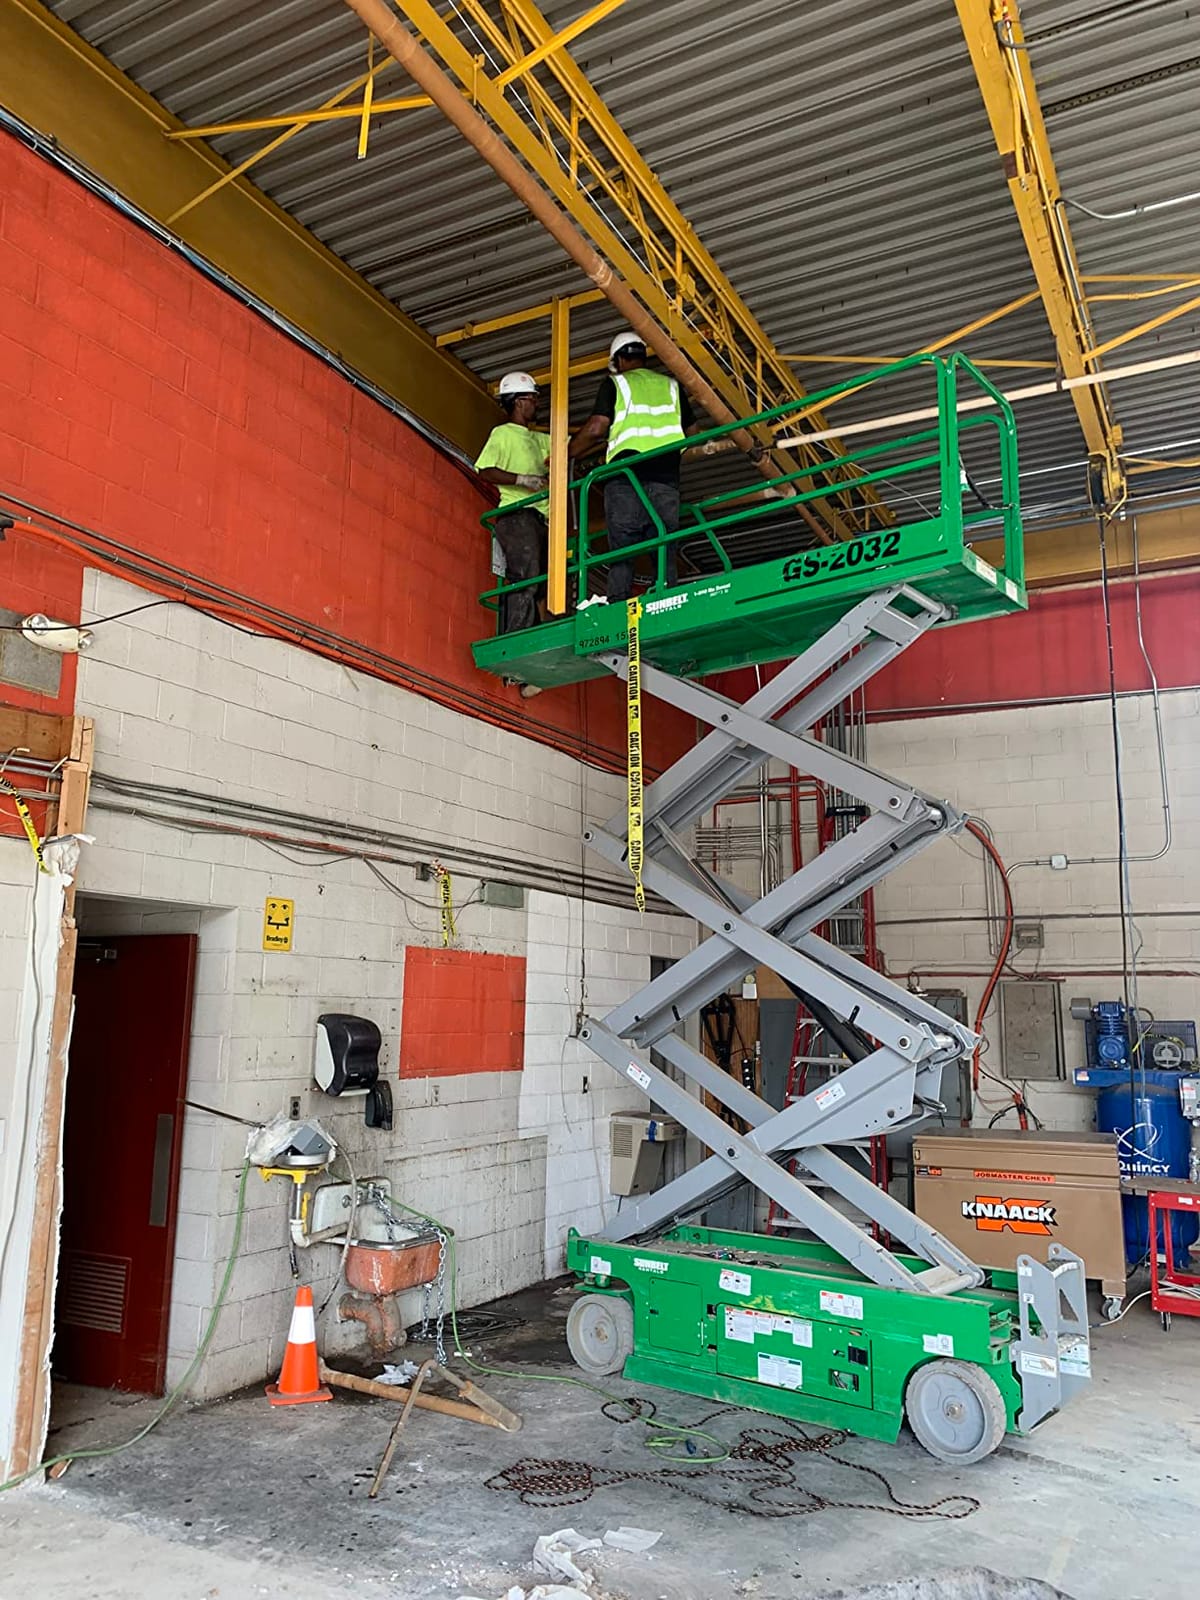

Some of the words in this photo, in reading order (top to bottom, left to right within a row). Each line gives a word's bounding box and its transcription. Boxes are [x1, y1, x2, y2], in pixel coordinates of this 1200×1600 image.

[783, 531, 901, 582] GS-2032
[645, 592, 689, 613] SUNBELT
[579, 635, 610, 648] 972894
[615, 630, 629, 641] 15
[629, 627, 638, 662] CAUTION
[629, 665, 638, 700] CAUTION
[629, 731, 640, 768] CAUTION
[630, 771, 641, 807] CAUTION
[630, 840, 641, 871] CAUTIO
[975, 1171, 1024, 1181] JOBMASTER
[1025, 1174, 1052, 1182] CHEST
[961, 1200, 1056, 1225] KNAACK
